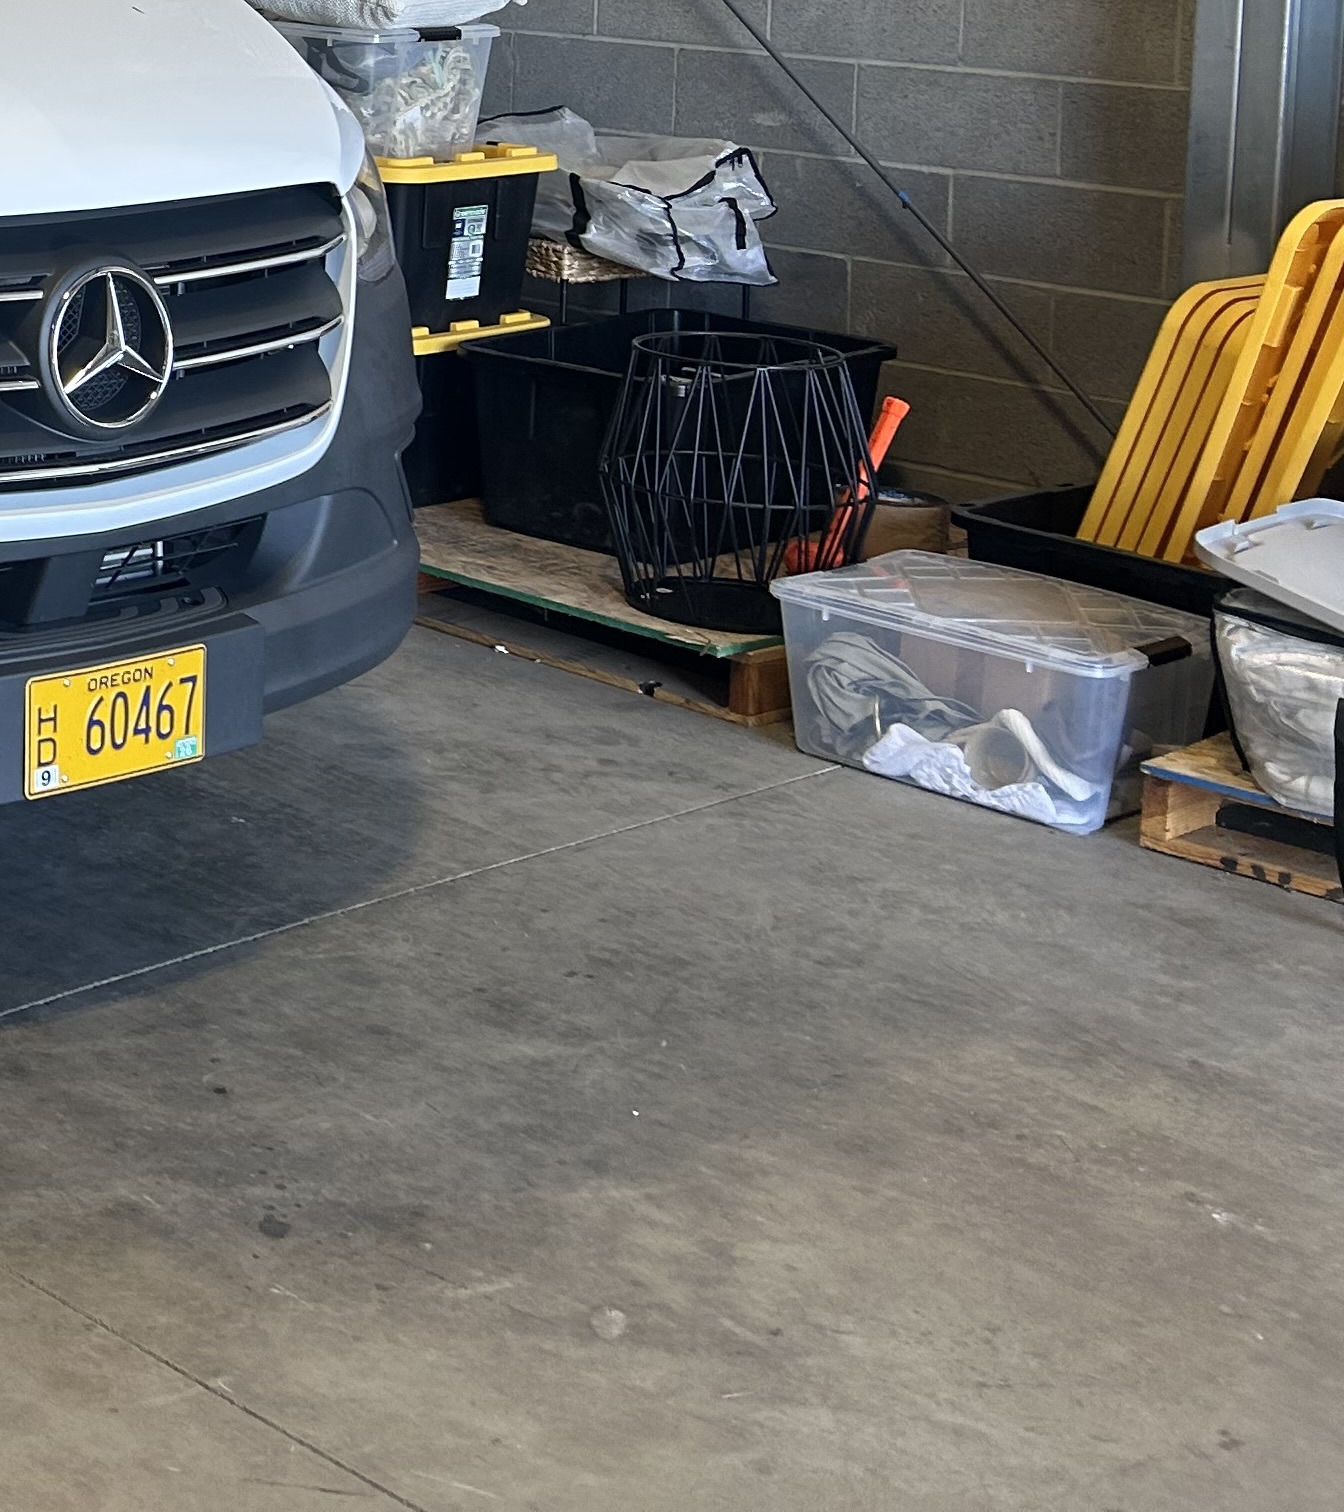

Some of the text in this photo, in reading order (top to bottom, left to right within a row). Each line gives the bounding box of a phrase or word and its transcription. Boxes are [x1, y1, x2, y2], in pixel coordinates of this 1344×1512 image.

[87, 666, 154, 692] OREGON
[85, 674, 198, 756] 60467
[41, 770, 51, 786] 9
